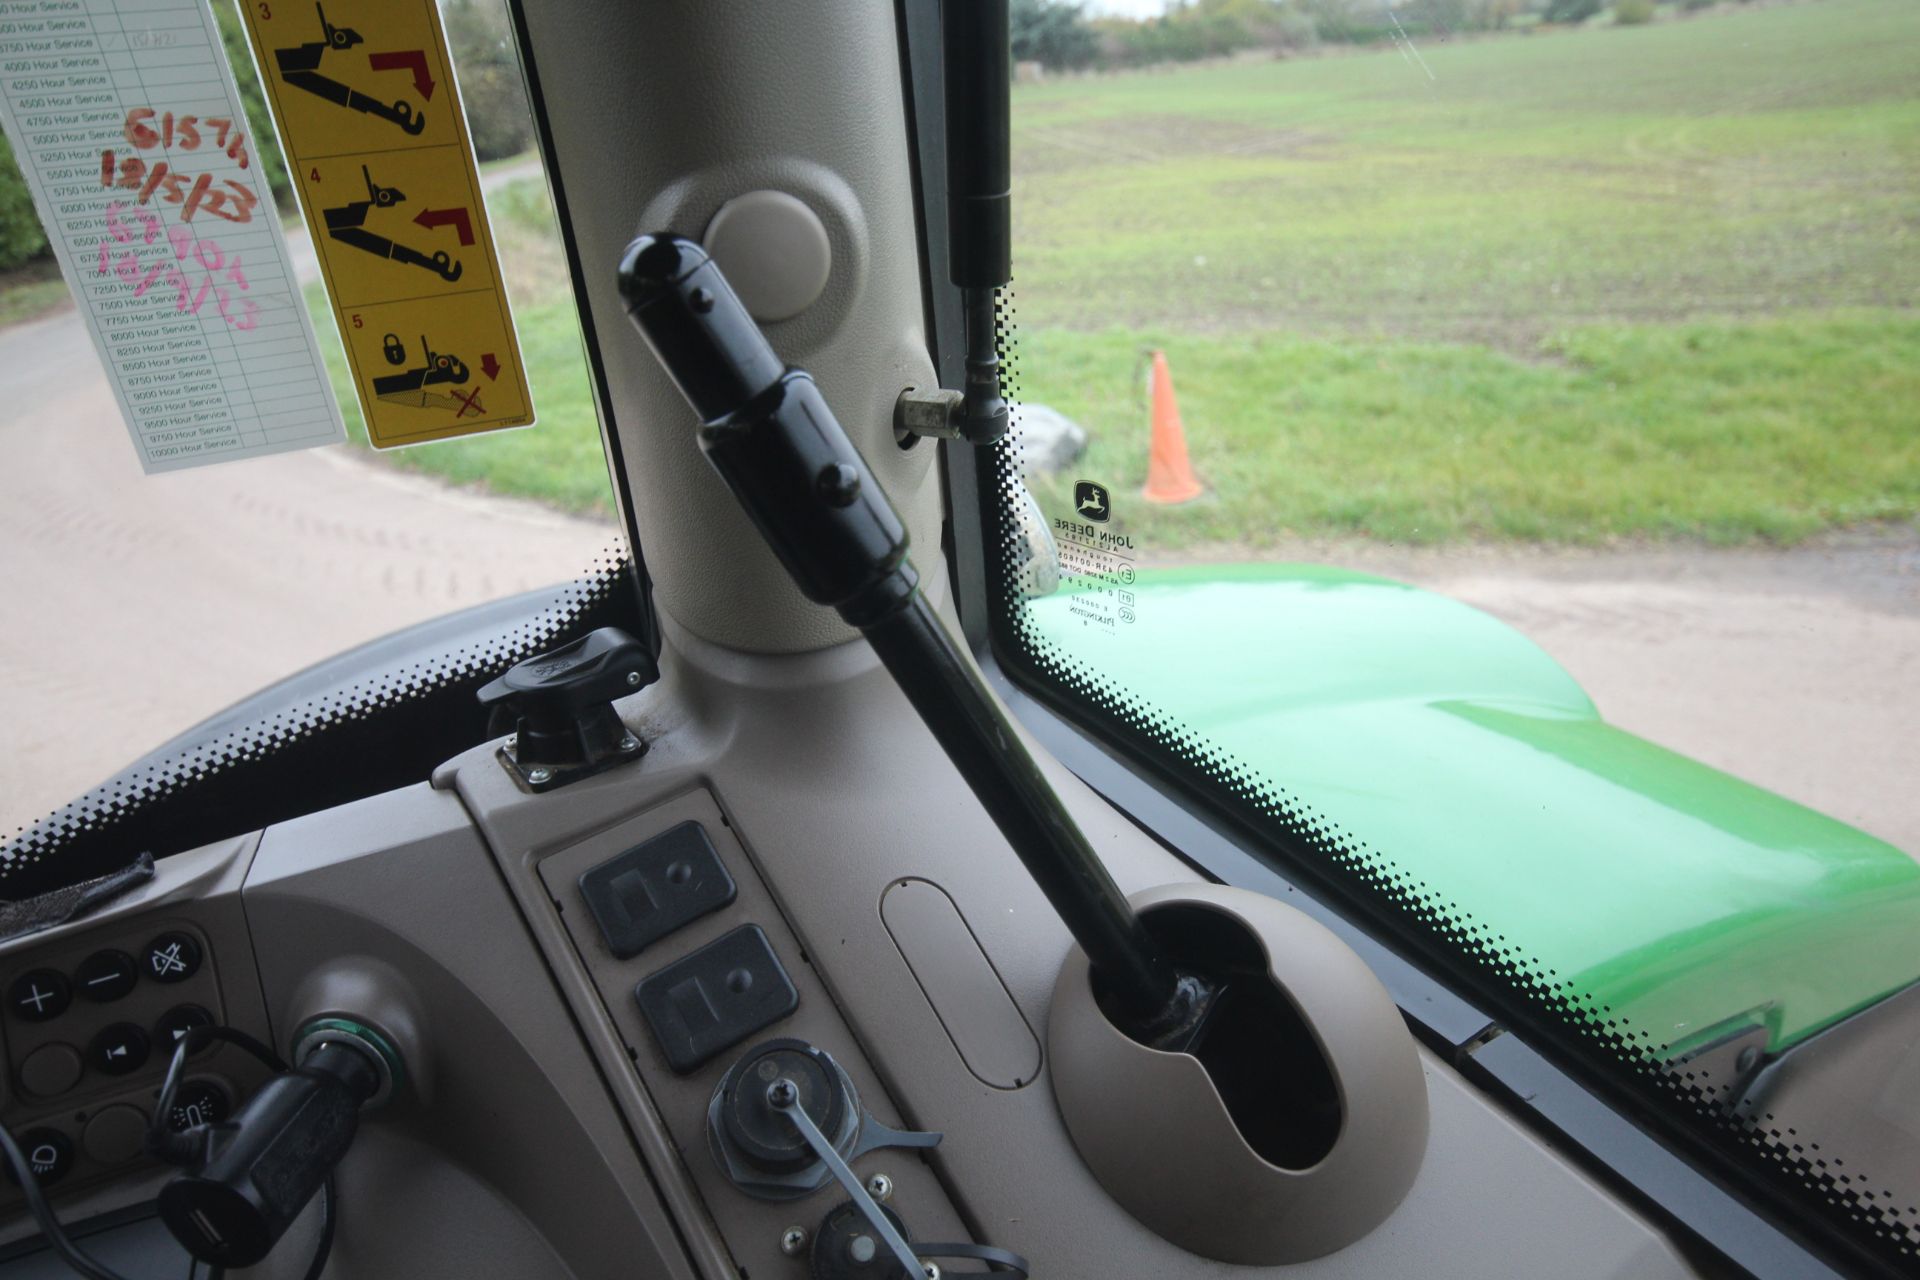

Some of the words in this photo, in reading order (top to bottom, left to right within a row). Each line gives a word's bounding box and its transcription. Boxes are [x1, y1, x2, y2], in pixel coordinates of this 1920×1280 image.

[11, 3, 37, 14] Hour
[39, 0, 80, 12] Service
[259, 2, 272, 20] 3
[18, 22, 44, 33] Hour
[46, 19, 87, 31] Service
[26, 40, 51, 52] Hour
[53, 38, 94, 50] Service
[32, 59, 59, 71] Hour
[60, 57, 100, 69] Service
[40, 77, 65, 89] Hour
[67, 75, 106, 87] Service
[46, 96, 72, 107] Hour
[74, 93, 113, 105] Service
[54, 114, 79, 125] Hour
[81, 110, 120, 122] Service
[61, 132, 86, 143] Hour
[67, 149, 93, 161] Hour
[74, 166, 99, 178] Hour
[310, 167, 321, 184] 4
[81, 184, 106, 195] Hour
[88, 201, 112, 212] Hour
[94, 217, 118, 228] Hour
[106, 250, 131, 261] Hour
[132, 246, 169, 257] Service
[113, 266, 136, 277] Hour
[138, 262, 174, 273] Service
[118, 282, 142, 293] Hour
[124, 297, 149, 308] Hour
[150, 294, 186, 306] Service
[130, 313, 154, 323] Hour
[155, 309, 191, 320] Service
[352, 314, 364, 329] 5
[136, 328, 160, 338] Hour
[161, 323, 197, 334] Service
[142, 342, 166, 353] Hour
[167, 338, 202, 350] Service
[147, 357, 171, 369] Hour
[172, 352, 207, 364] Service
[153, 371, 176, 383] Hour
[177, 367, 212, 379] Service
[158, 386, 182, 398] Hour
[183, 382, 218, 394] Service
[164, 400, 187, 412] Hour
[188, 396, 223, 408] Service
[169, 415, 192, 426] Hour
[193, 410, 227, 422] Service
[174, 429, 197, 440] Hour
[198, 424, 232, 436] Service
[179, 443, 203, 455] Hour
[203, 438, 237, 450] Service
